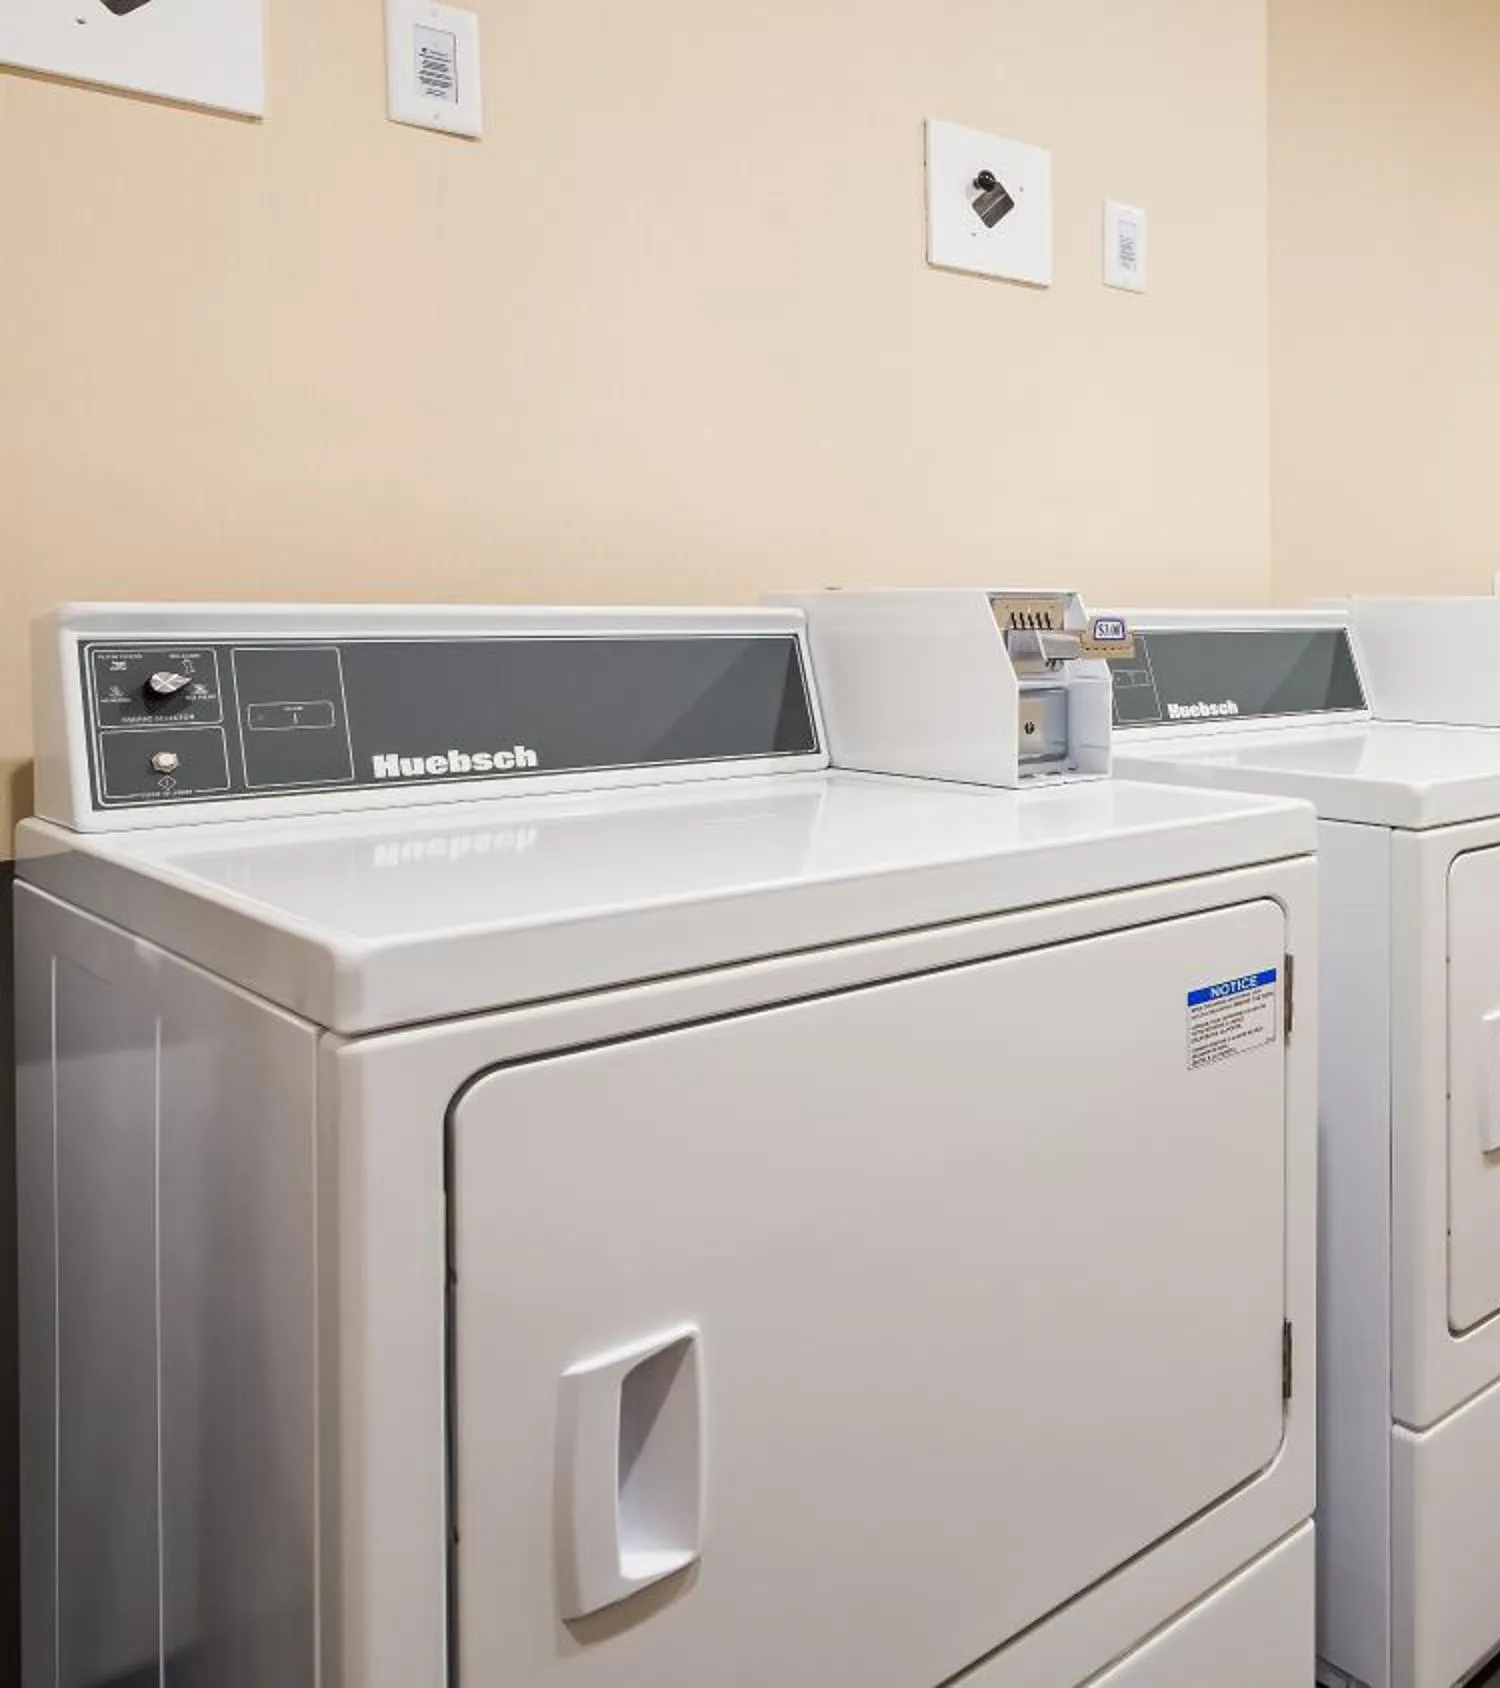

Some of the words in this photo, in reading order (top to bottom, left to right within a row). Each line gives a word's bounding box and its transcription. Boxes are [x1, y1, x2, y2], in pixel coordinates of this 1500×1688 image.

[1168, 700, 1238, 718] Huebsch
[372, 745, 537, 778] Huebsch
[1210, 976, 1258, 998] NOTICE
